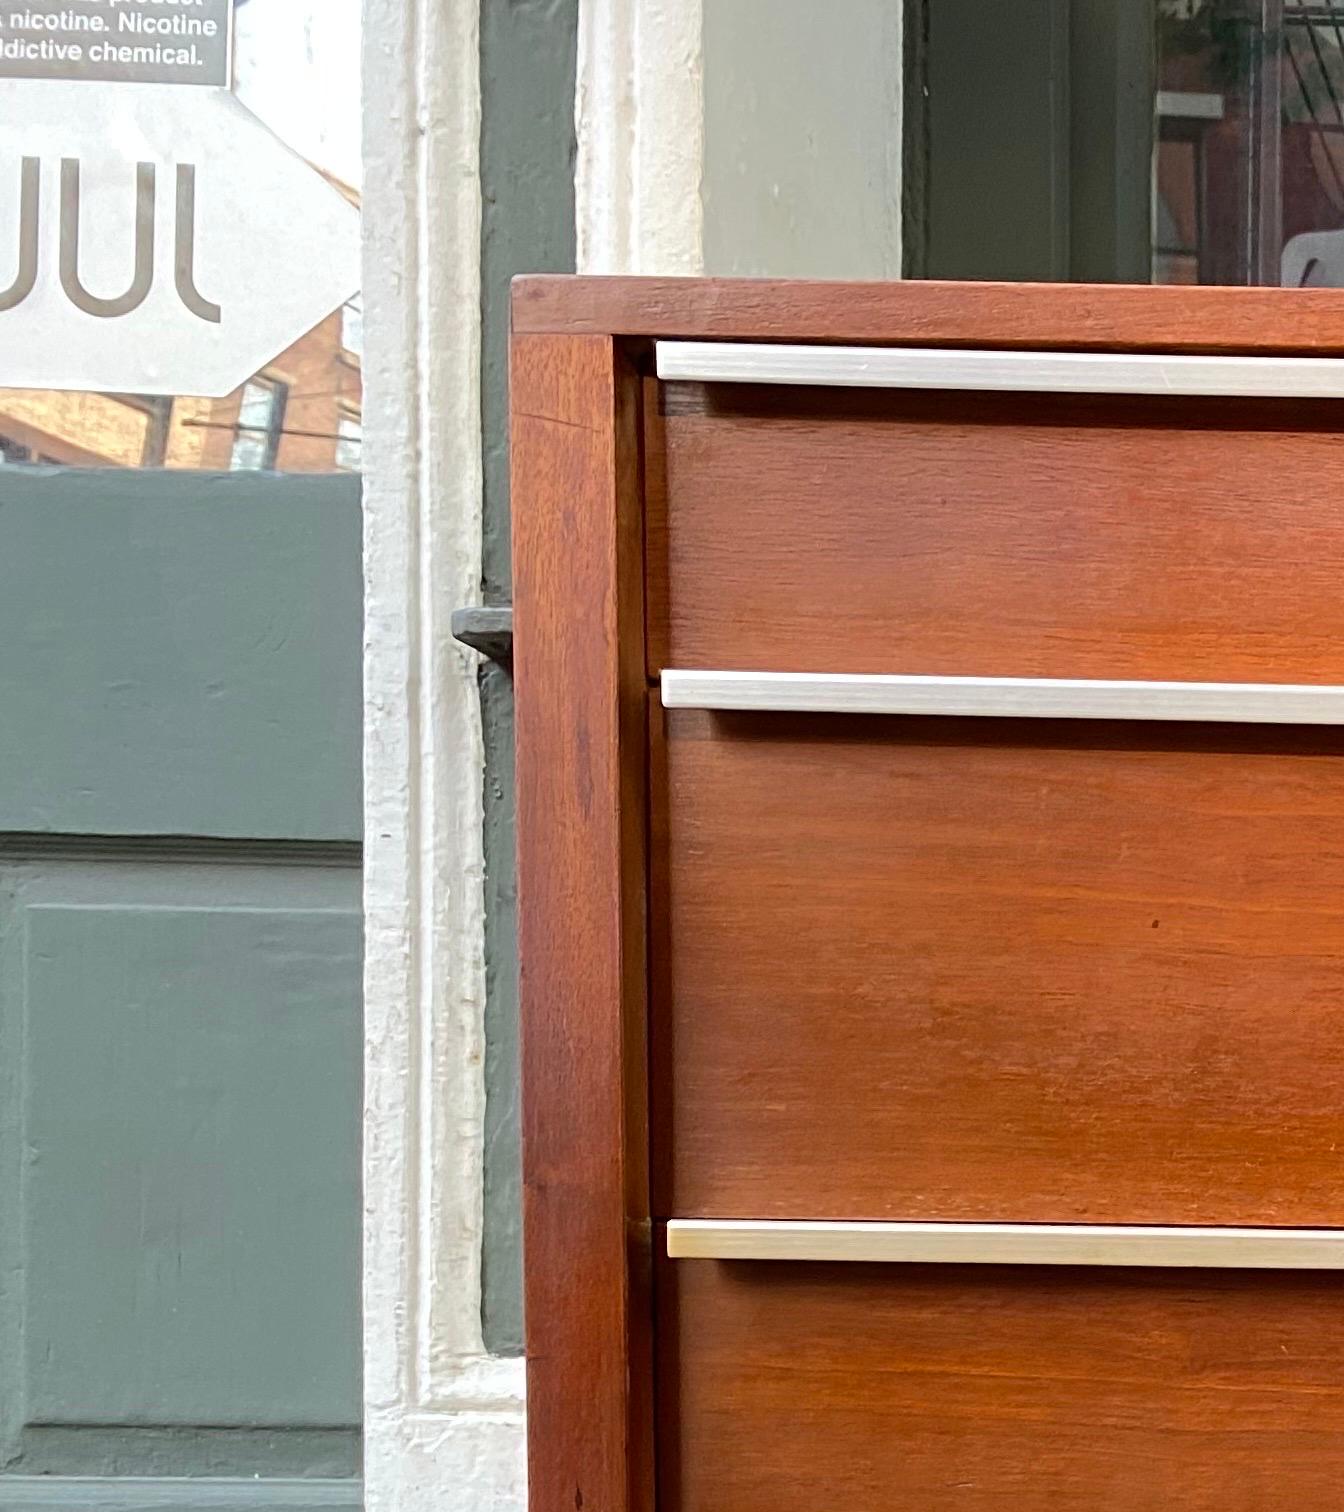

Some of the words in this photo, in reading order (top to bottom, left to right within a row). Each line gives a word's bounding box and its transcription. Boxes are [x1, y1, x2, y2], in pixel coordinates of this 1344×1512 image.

[10, 9, 110, 32] nicotine.
[118, 12, 218, 36] Nicotine
[0, 37, 82, 61] dictive
[88, 42, 204, 66] chemical.
